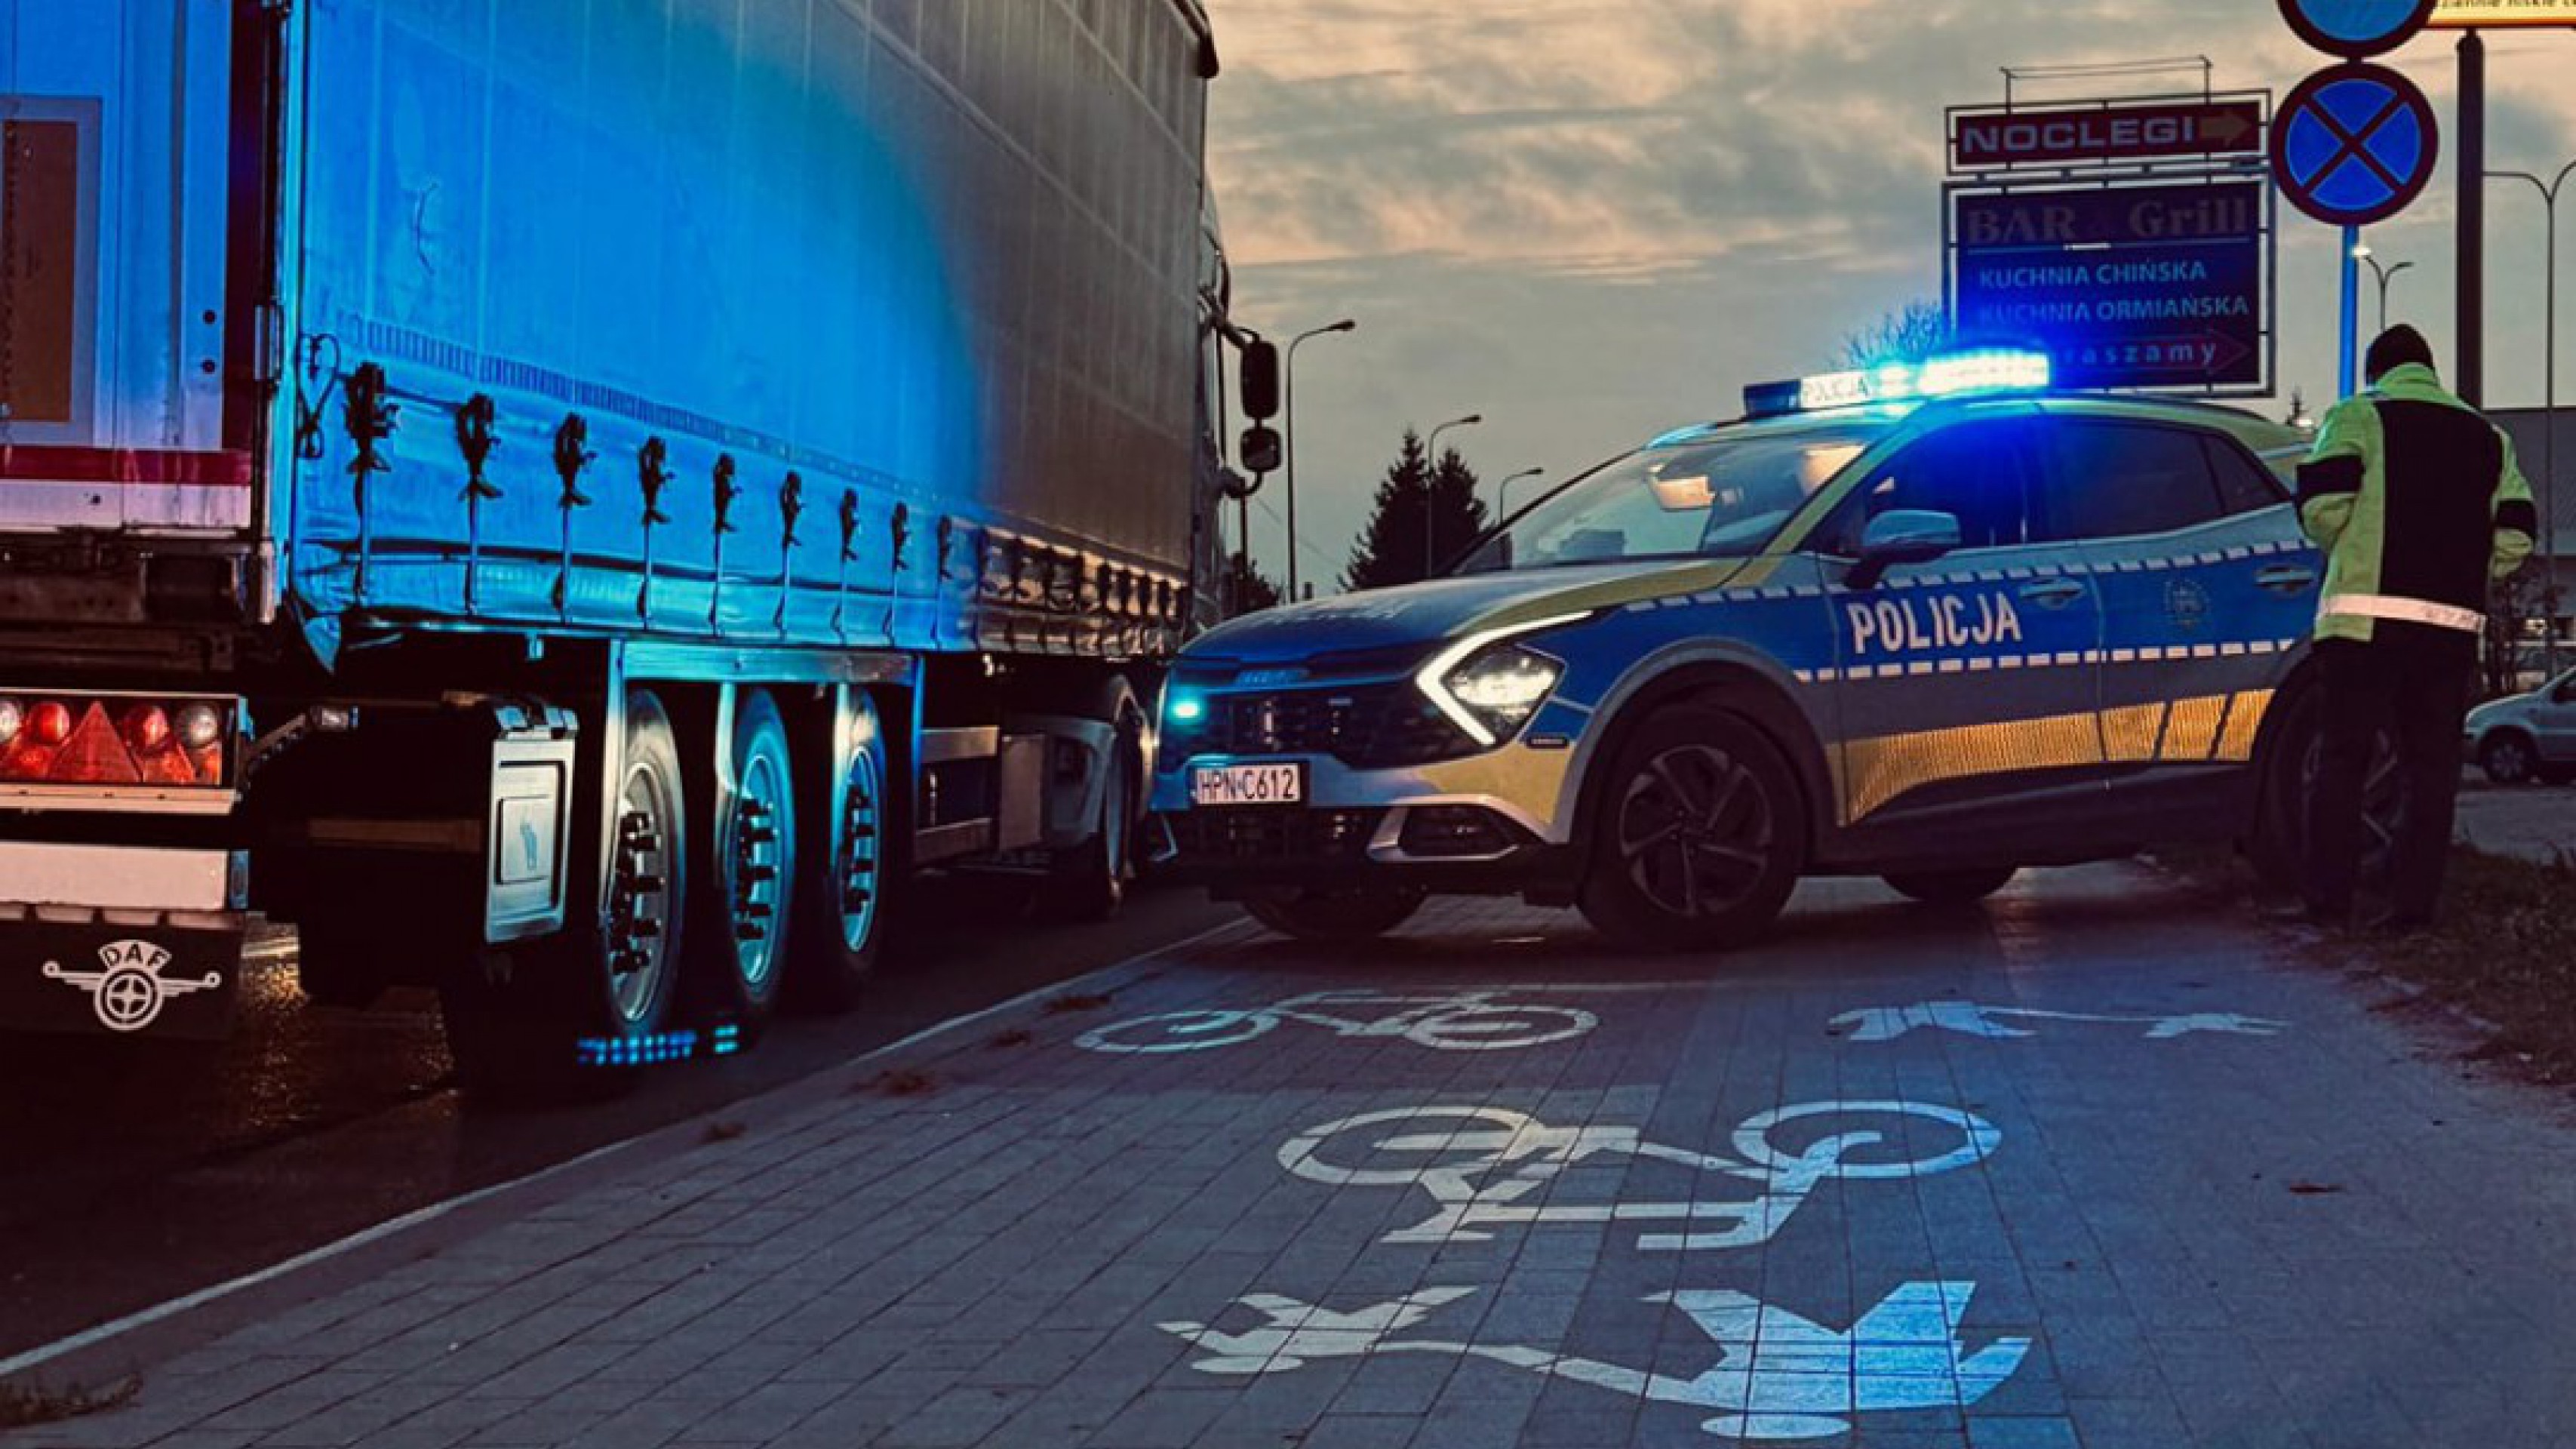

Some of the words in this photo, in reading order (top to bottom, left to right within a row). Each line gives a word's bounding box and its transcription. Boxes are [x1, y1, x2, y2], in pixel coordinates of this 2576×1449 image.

[1963, 115, 2195, 153] NOCLEGI
[1967, 205, 2076, 244] BAR
[2129, 197, 2248, 238] Grill
[1980, 266, 2090, 289] KUCHNIA
[2096, 258, 2207, 285] CHIŃSKA
[2096, 293, 2250, 321] ORMIAŃSKA
[1846, 591, 2024, 654] POLICJA
[1243, 766, 1296, 800] C612
[102, 943, 168, 968] DAF
